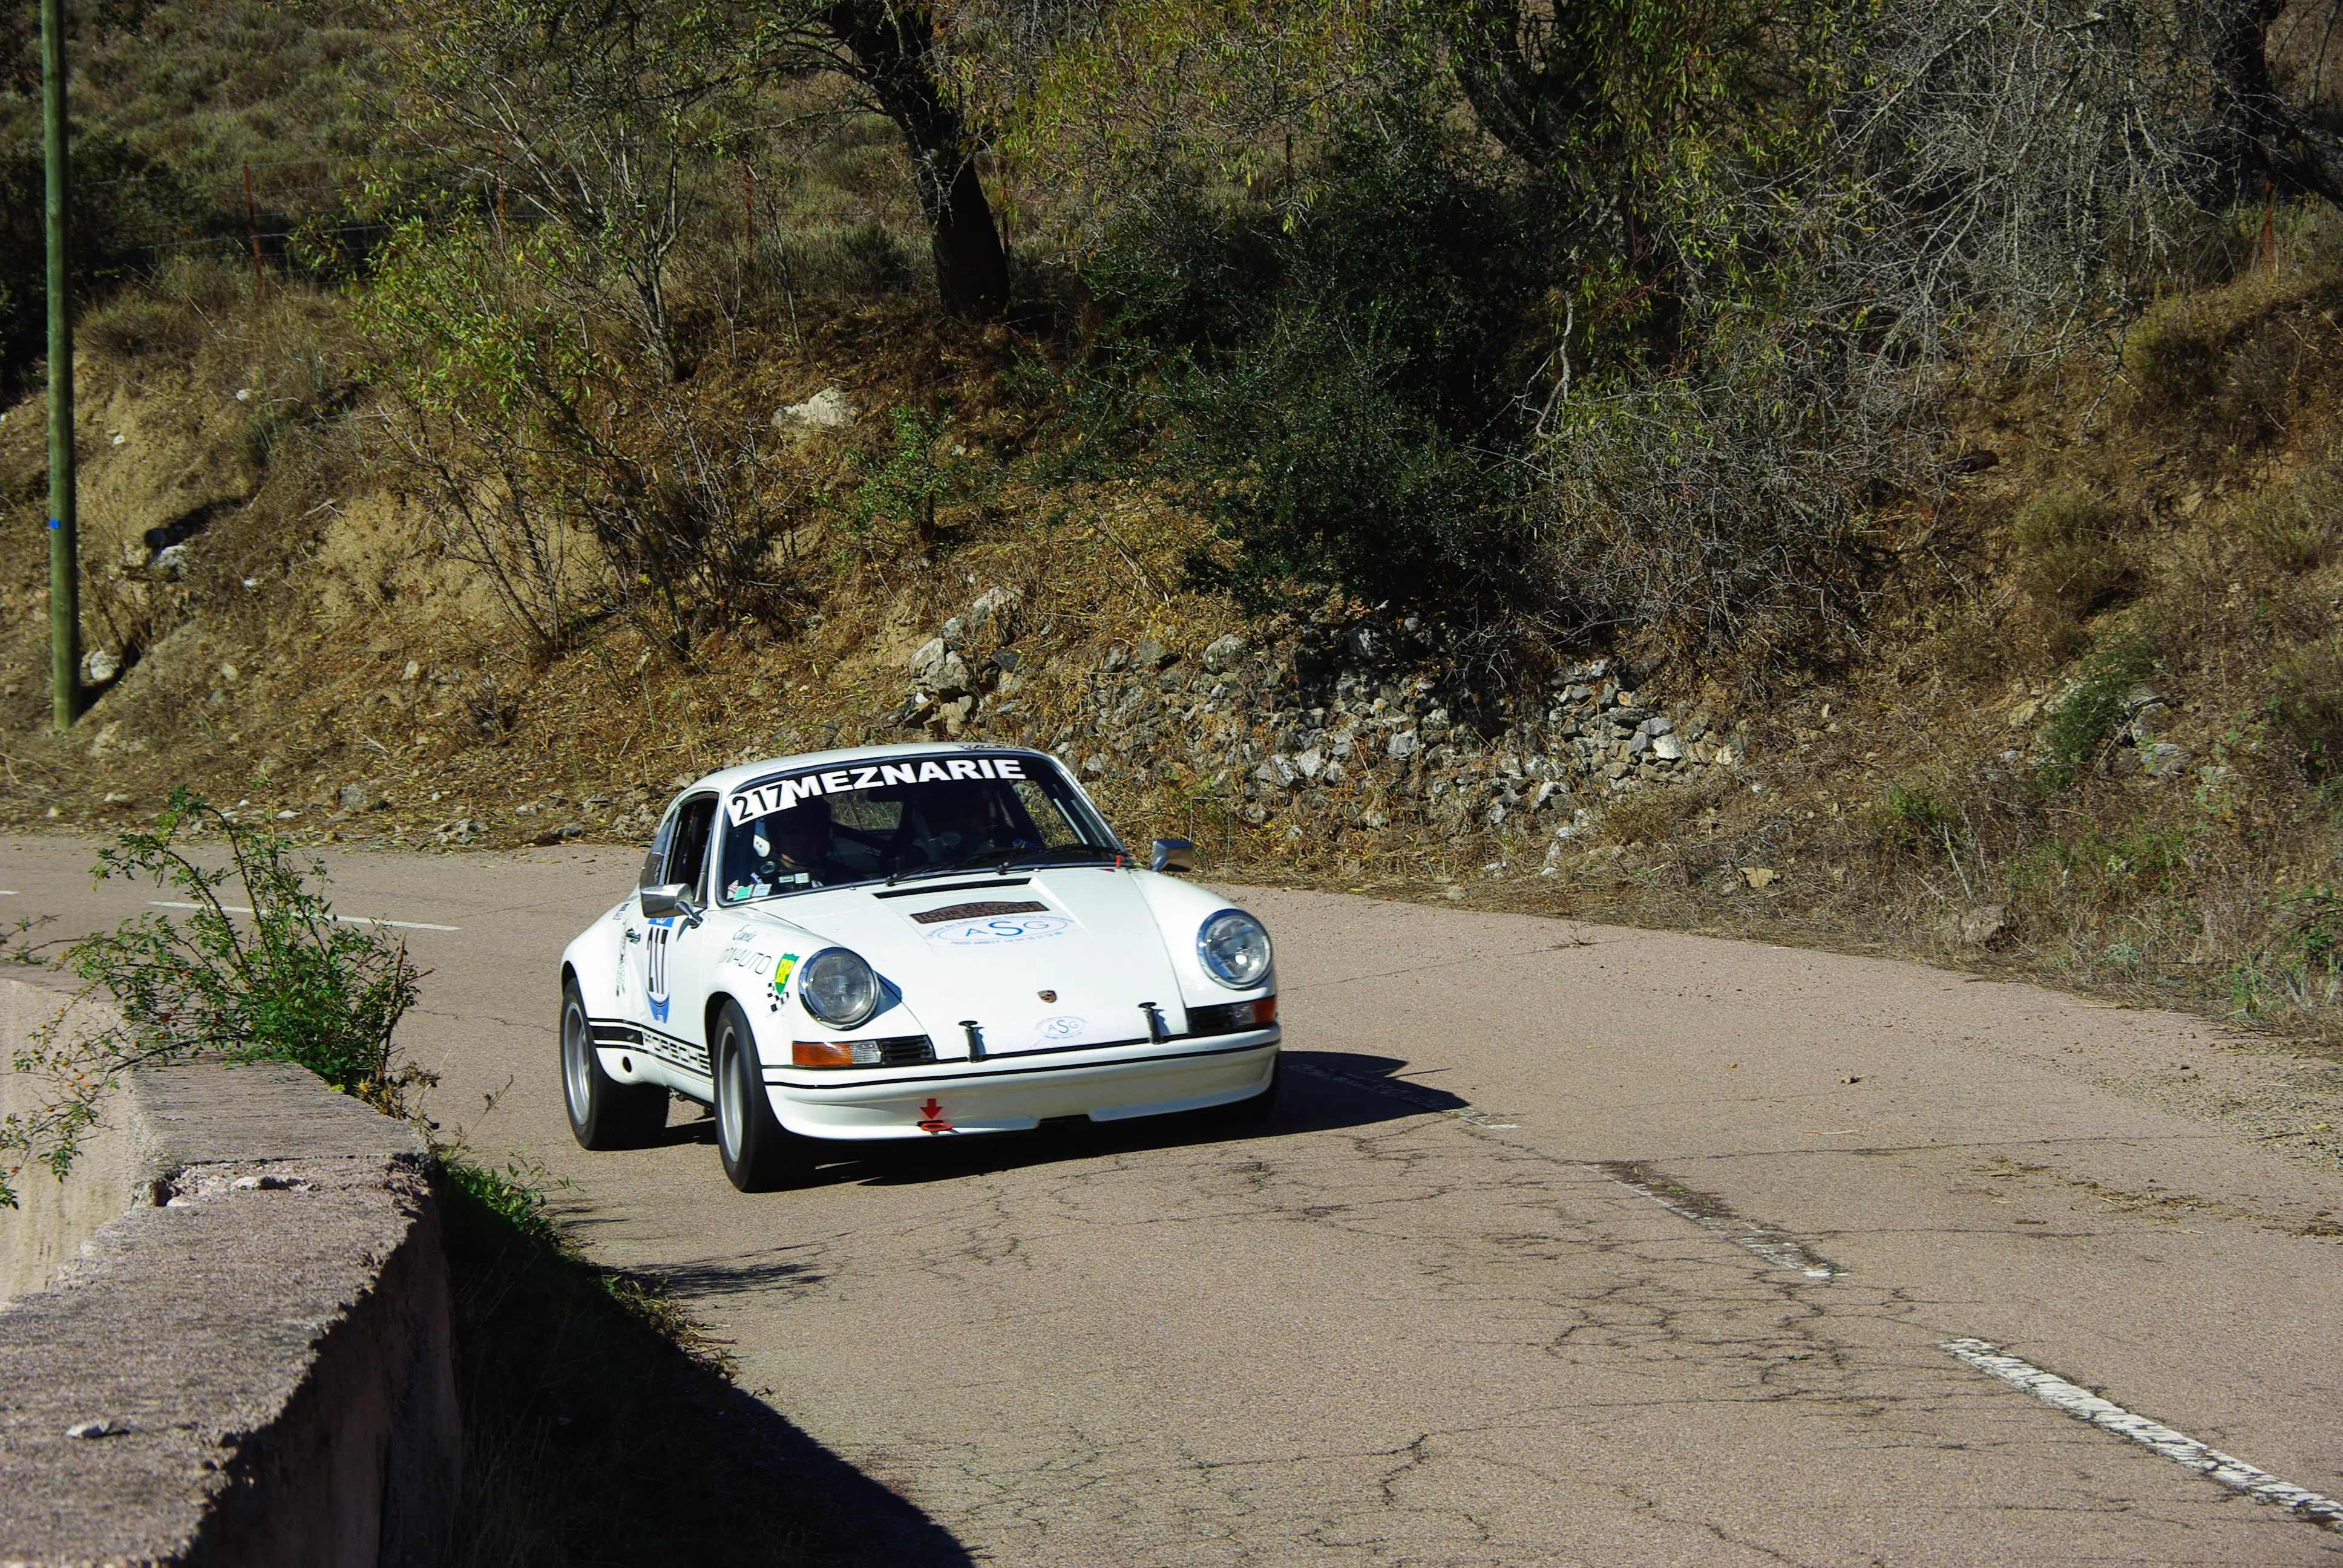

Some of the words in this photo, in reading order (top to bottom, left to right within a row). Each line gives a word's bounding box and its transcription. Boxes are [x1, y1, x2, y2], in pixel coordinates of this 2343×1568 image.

[732, 783, 783, 822] 217
[785, 759, 1027, 799] MEZNARIE
[965, 921, 1049, 937] ASG
[646, 926, 669, 995] 217
[775, 958, 795, 984] BP
[1047, 1020, 1079, 1034] ASG
[643, 1031, 710, 1070] PORSCHE
